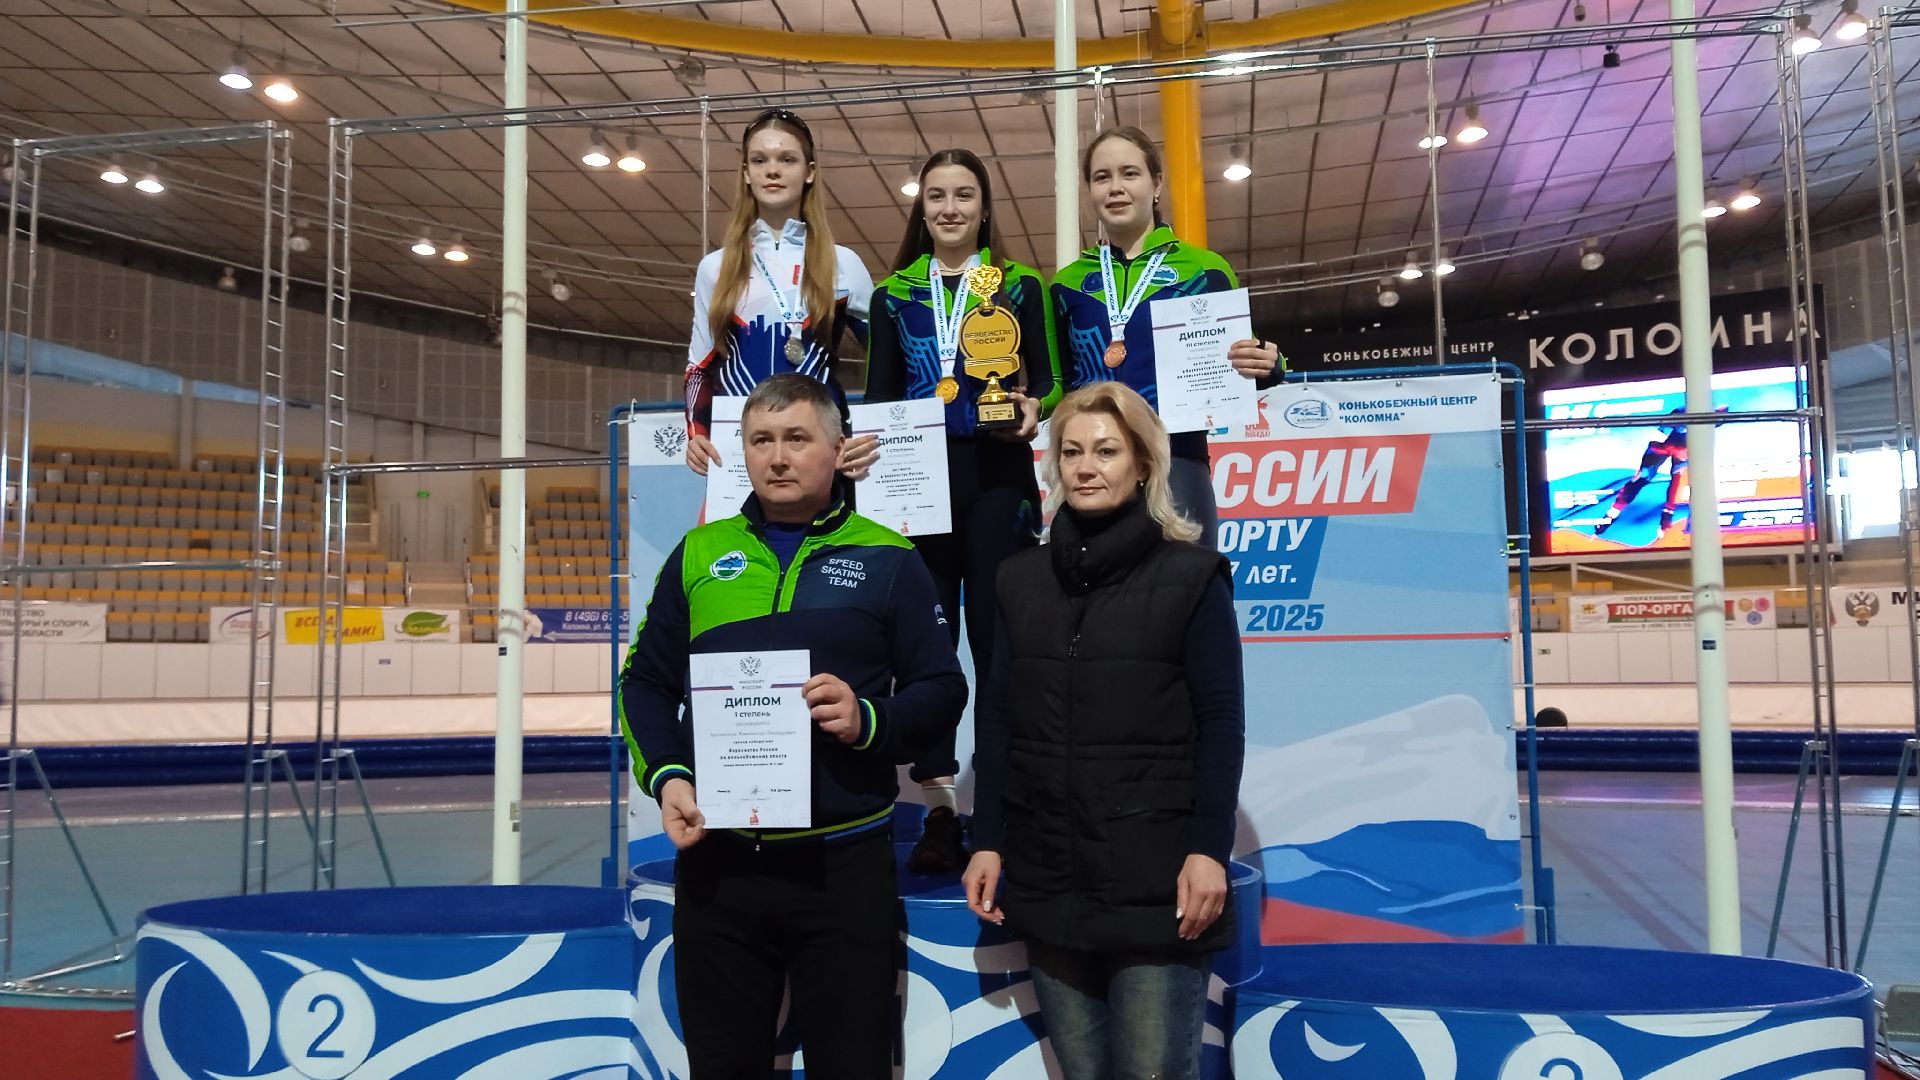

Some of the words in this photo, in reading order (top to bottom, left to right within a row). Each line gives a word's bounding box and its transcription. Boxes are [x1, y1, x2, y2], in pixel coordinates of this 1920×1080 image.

[973, 337, 1006, 345] РОССИИ
[1179, 327, 1226, 342] ДИПЛОМ
[1323, 345, 1440, 363] КОНЬКОБЕЖНЫ
[1451, 341, 1495, 355] ЦЕНТР
[1338, 395, 1438, 411] КОНЬКОБЕЖНЫЙ
[1440, 395, 1478, 407] ЦЕНТР
[1339, 412, 1406, 424] "КОЛОМНА"
[828, 558, 864, 571] SPEED
[820, 565, 866, 581] SKATING
[1245, 563, 1297, 585] лет.
[828, 576, 858, 589] TEAM
[565, 610, 573, 622] 8
[574, 610, 600, 622] (496)
[1246, 604, 1325, 632] 2025
[724, 696, 781, 709] ДИПЛОМ
[306, 993, 345, 1058] 2
